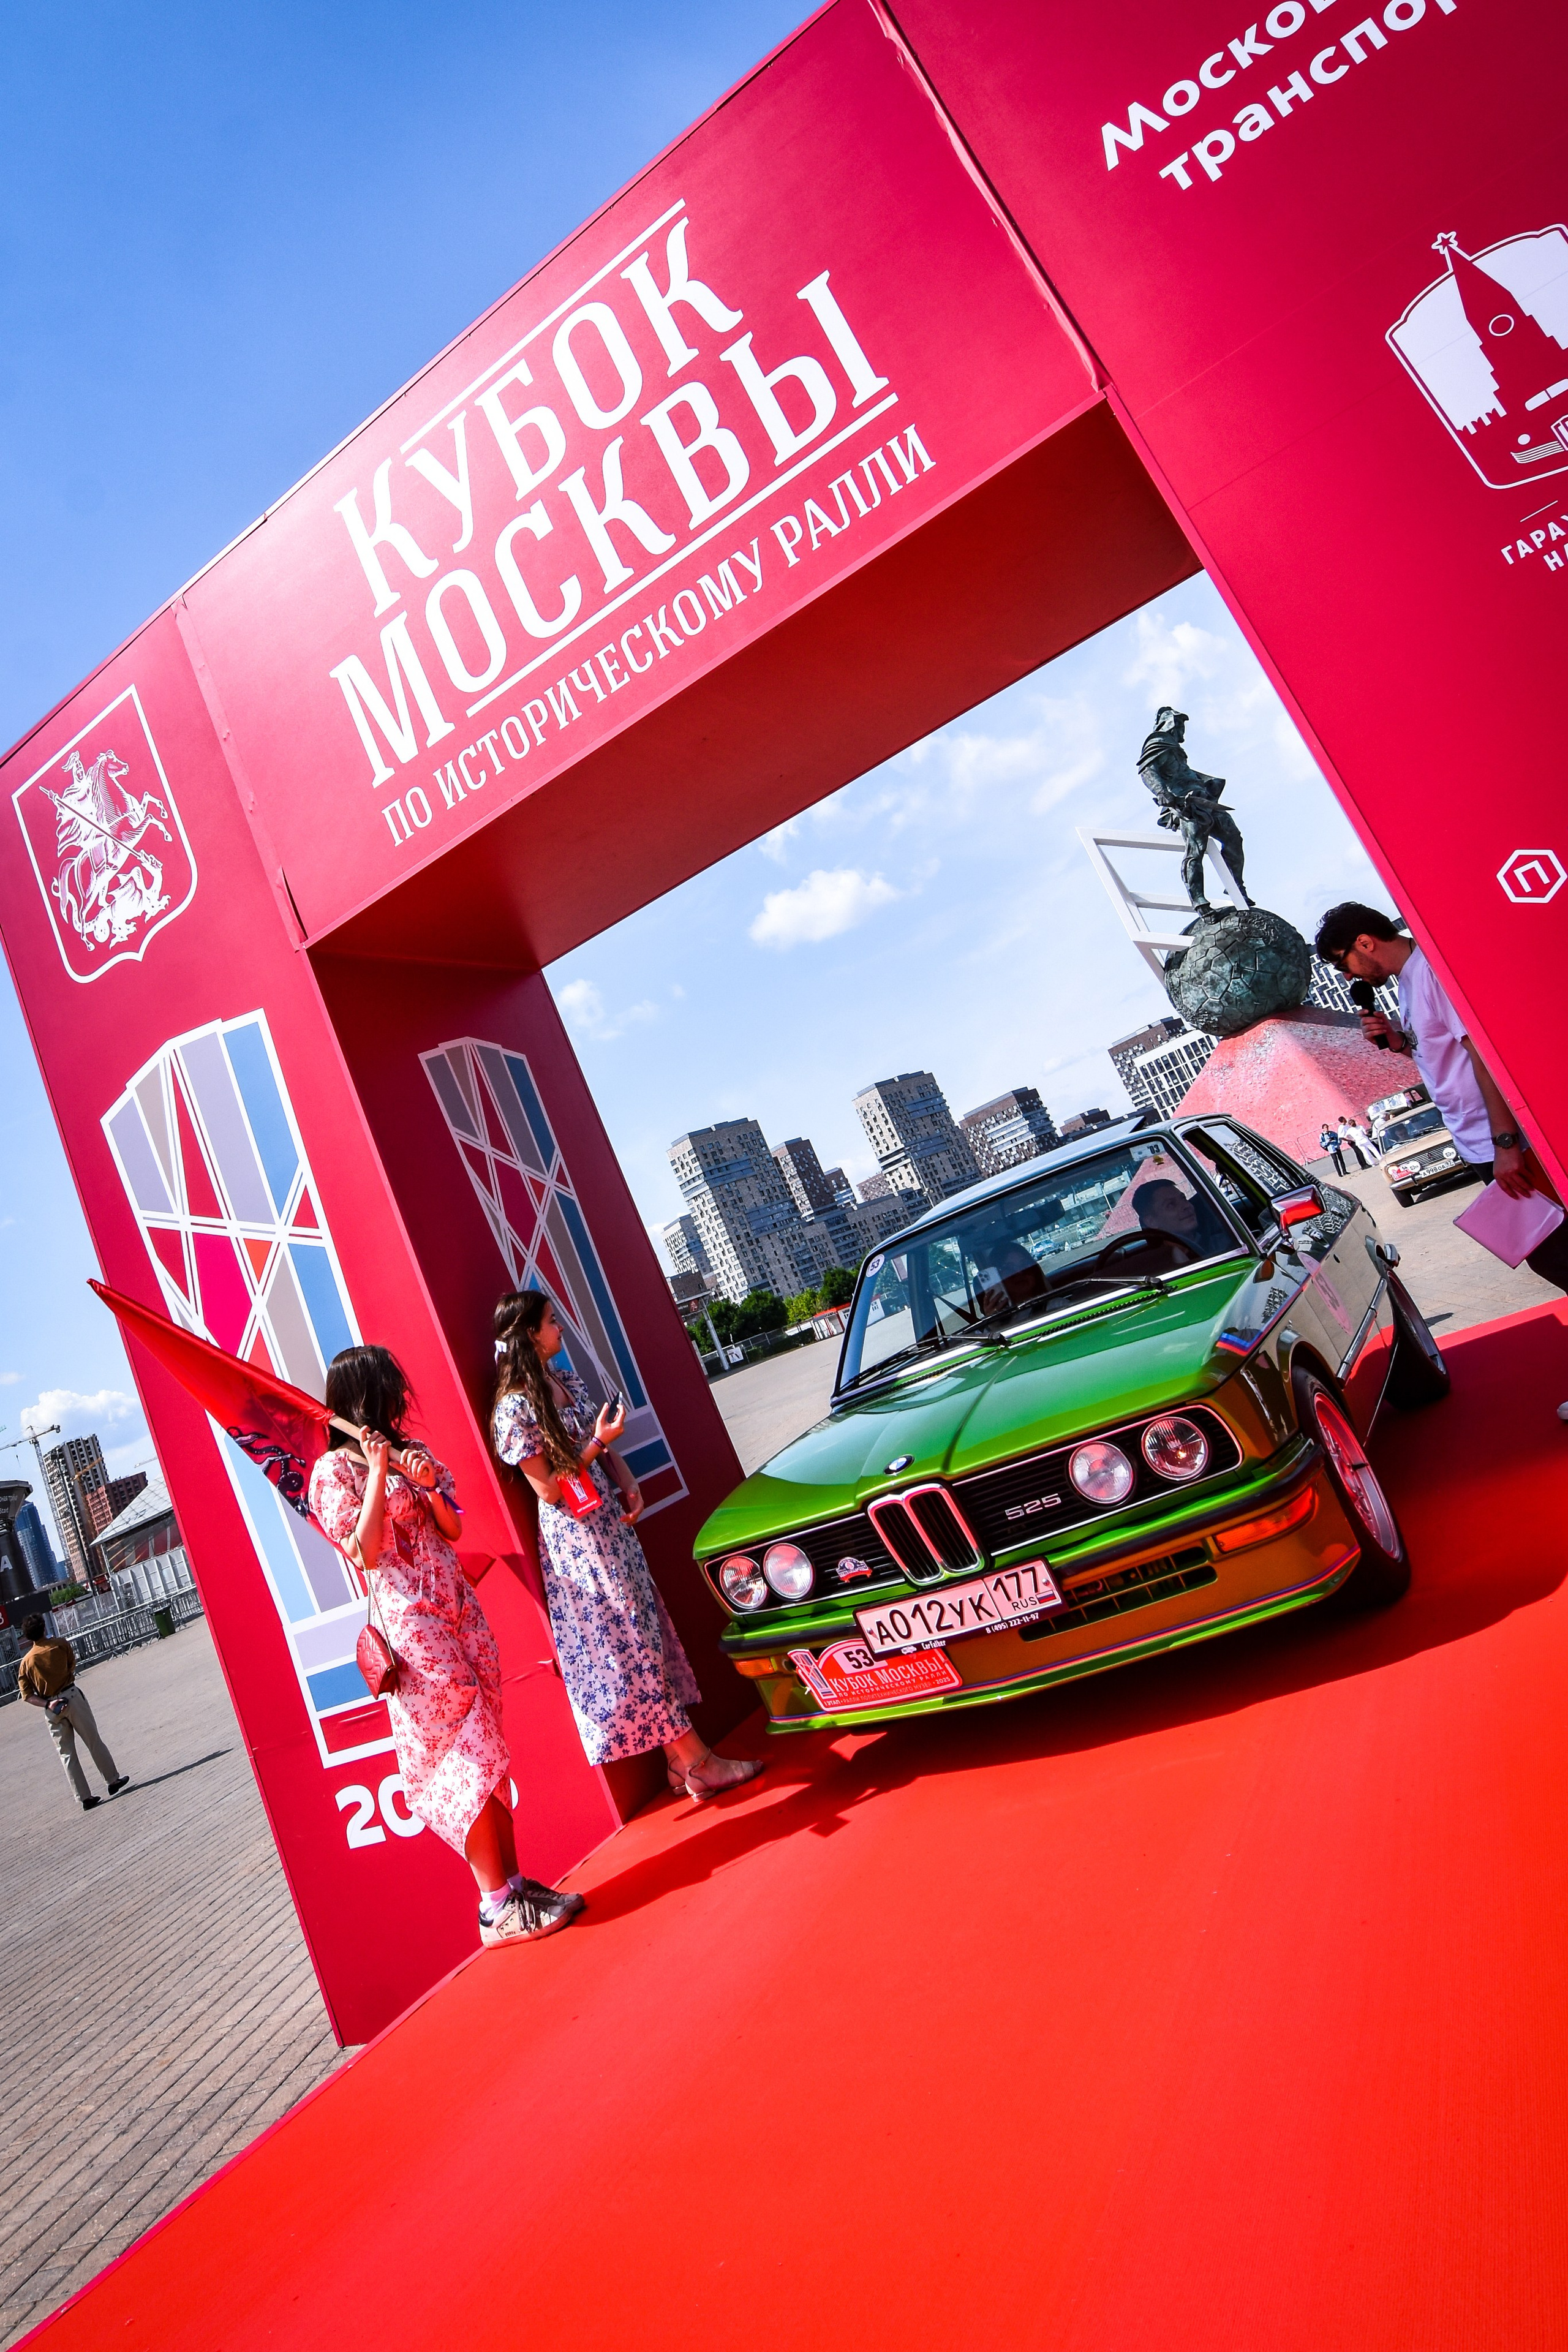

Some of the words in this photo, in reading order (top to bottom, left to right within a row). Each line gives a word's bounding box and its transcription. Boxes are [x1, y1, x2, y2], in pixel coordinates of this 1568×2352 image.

[334, 217, 744, 618] КУБОК
[329, 270, 889, 788] МОСКВЫ
[1543, 543, 1568, 571] Н
[382, 787, 432, 846] ПО
[433, 538, 763, 809] ИСТОРИЧЕСКОМУ
[771, 424, 936, 567] РАЛЛИ
[870, 1259, 880, 1272] 53
[1005, 1493, 1062, 1520] 525
[875, 1592, 995, 1645] А012УК
[992, 1566, 1040, 1602] 177
[1011, 1596, 1038, 1611] RUS
[992, 1621, 1009, 1634] (495)
[1009, 1612, 1039, 1627] 222-11-97
[843, 1648, 875, 1669] 53
[829, 1673, 878, 1692] КУБОК
[876, 1657, 943, 1685] МОСКВЫ
[851, 1678, 916, 1695] ИСТОРИЧЕСКОМУ
[919, 1670, 947, 1681] РАЛЛИ
[860, 1686, 913, 1701] ПОЛИТЕХНИЧЕСКОГО
[913, 1681, 932, 1690] МУЗЕЯ
